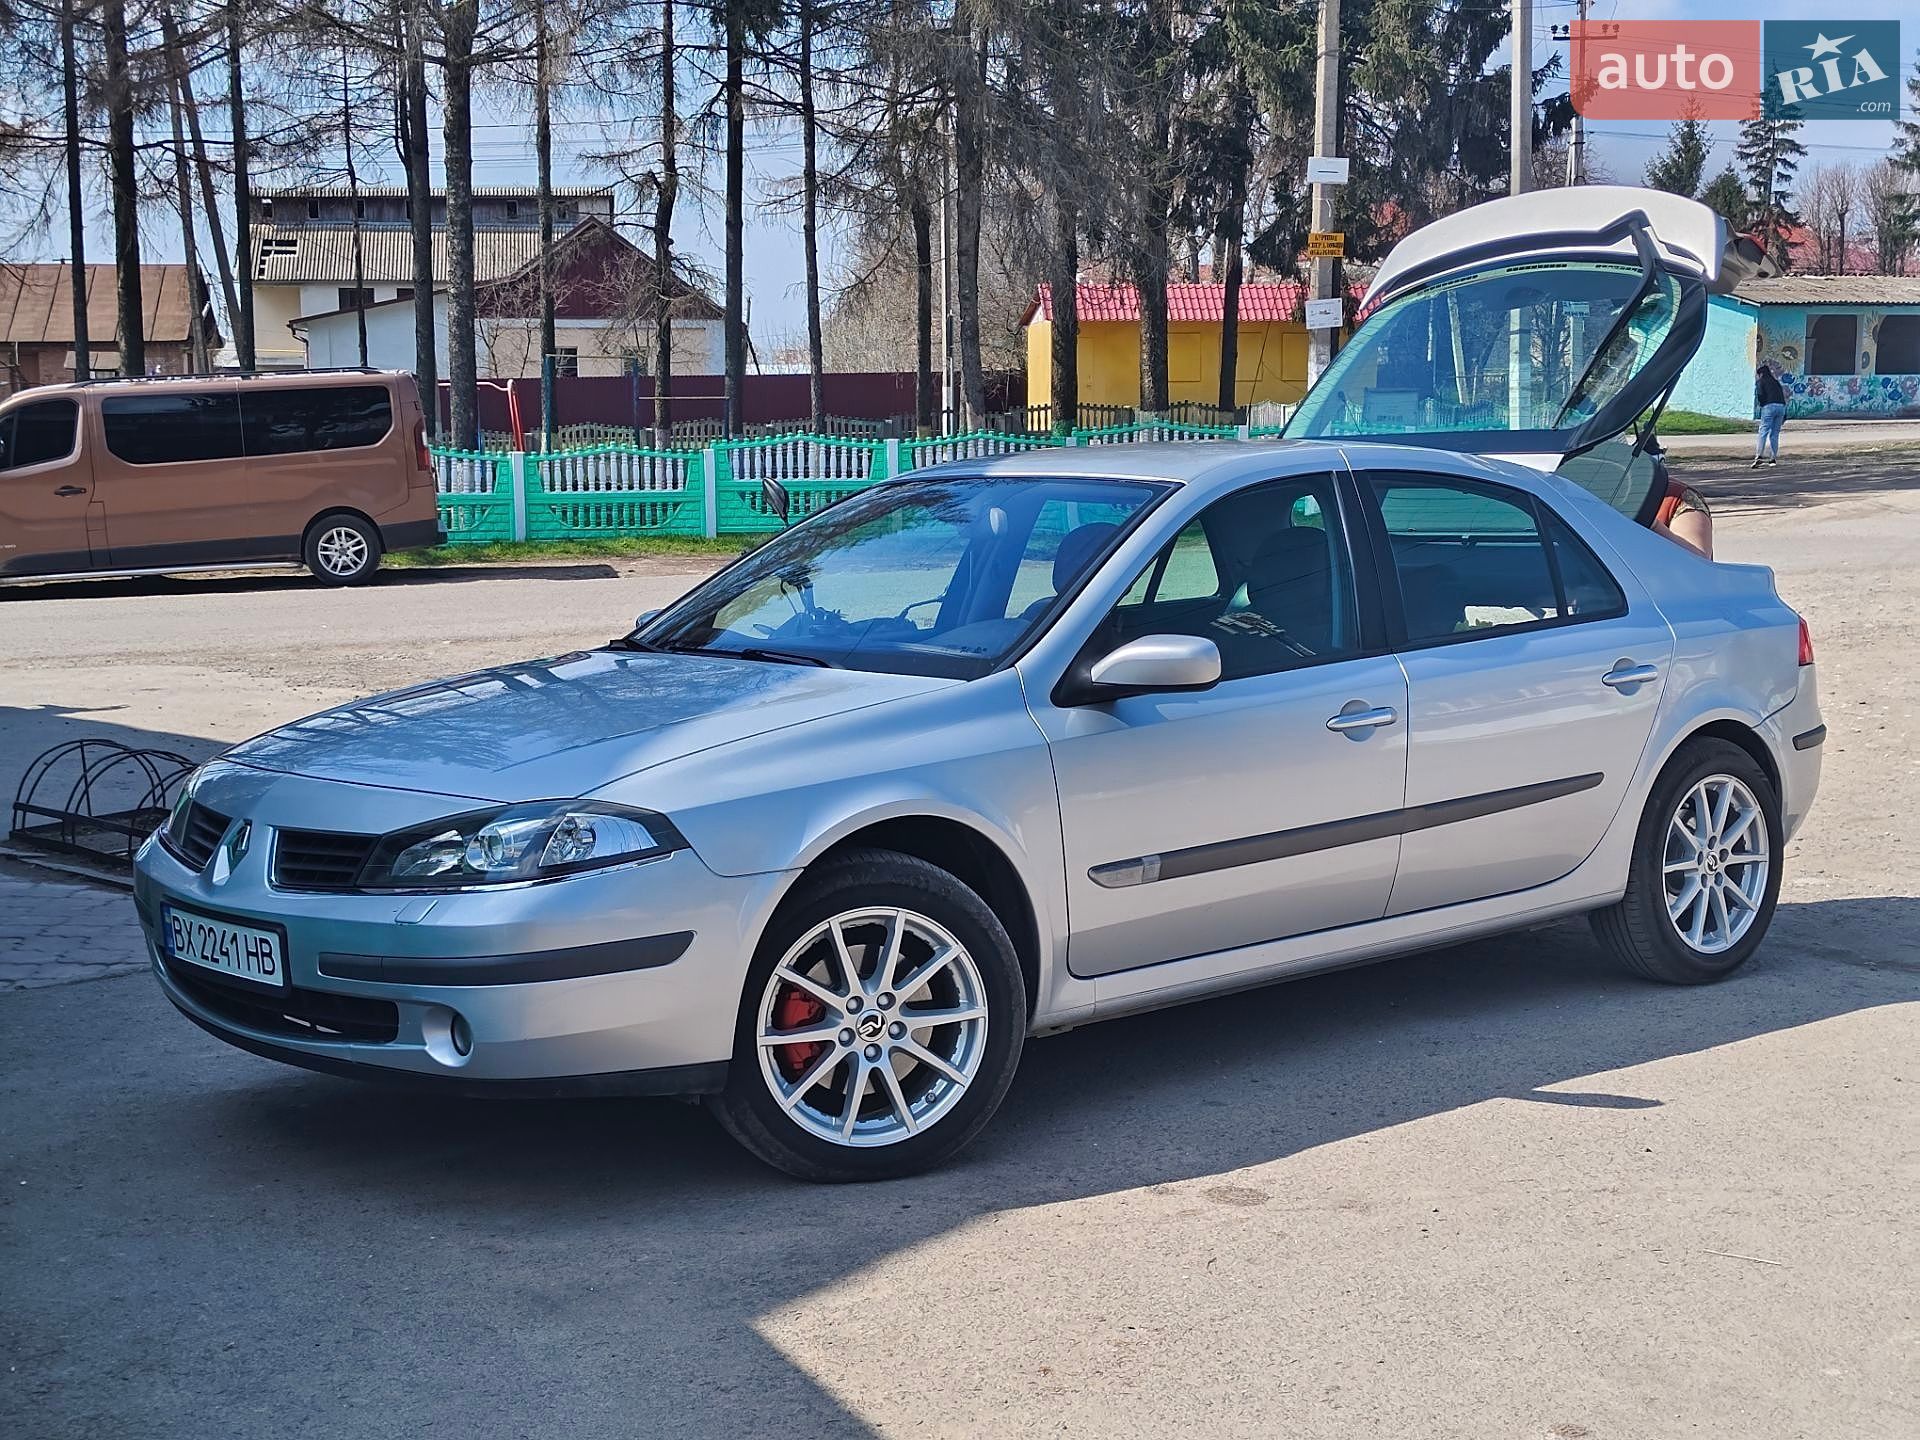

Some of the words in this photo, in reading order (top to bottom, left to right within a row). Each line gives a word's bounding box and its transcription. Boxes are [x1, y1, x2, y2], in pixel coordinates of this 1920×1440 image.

[172, 915, 196, 957] BX
[198, 924, 240, 969] 2241
[244, 934, 276, 975] HB
